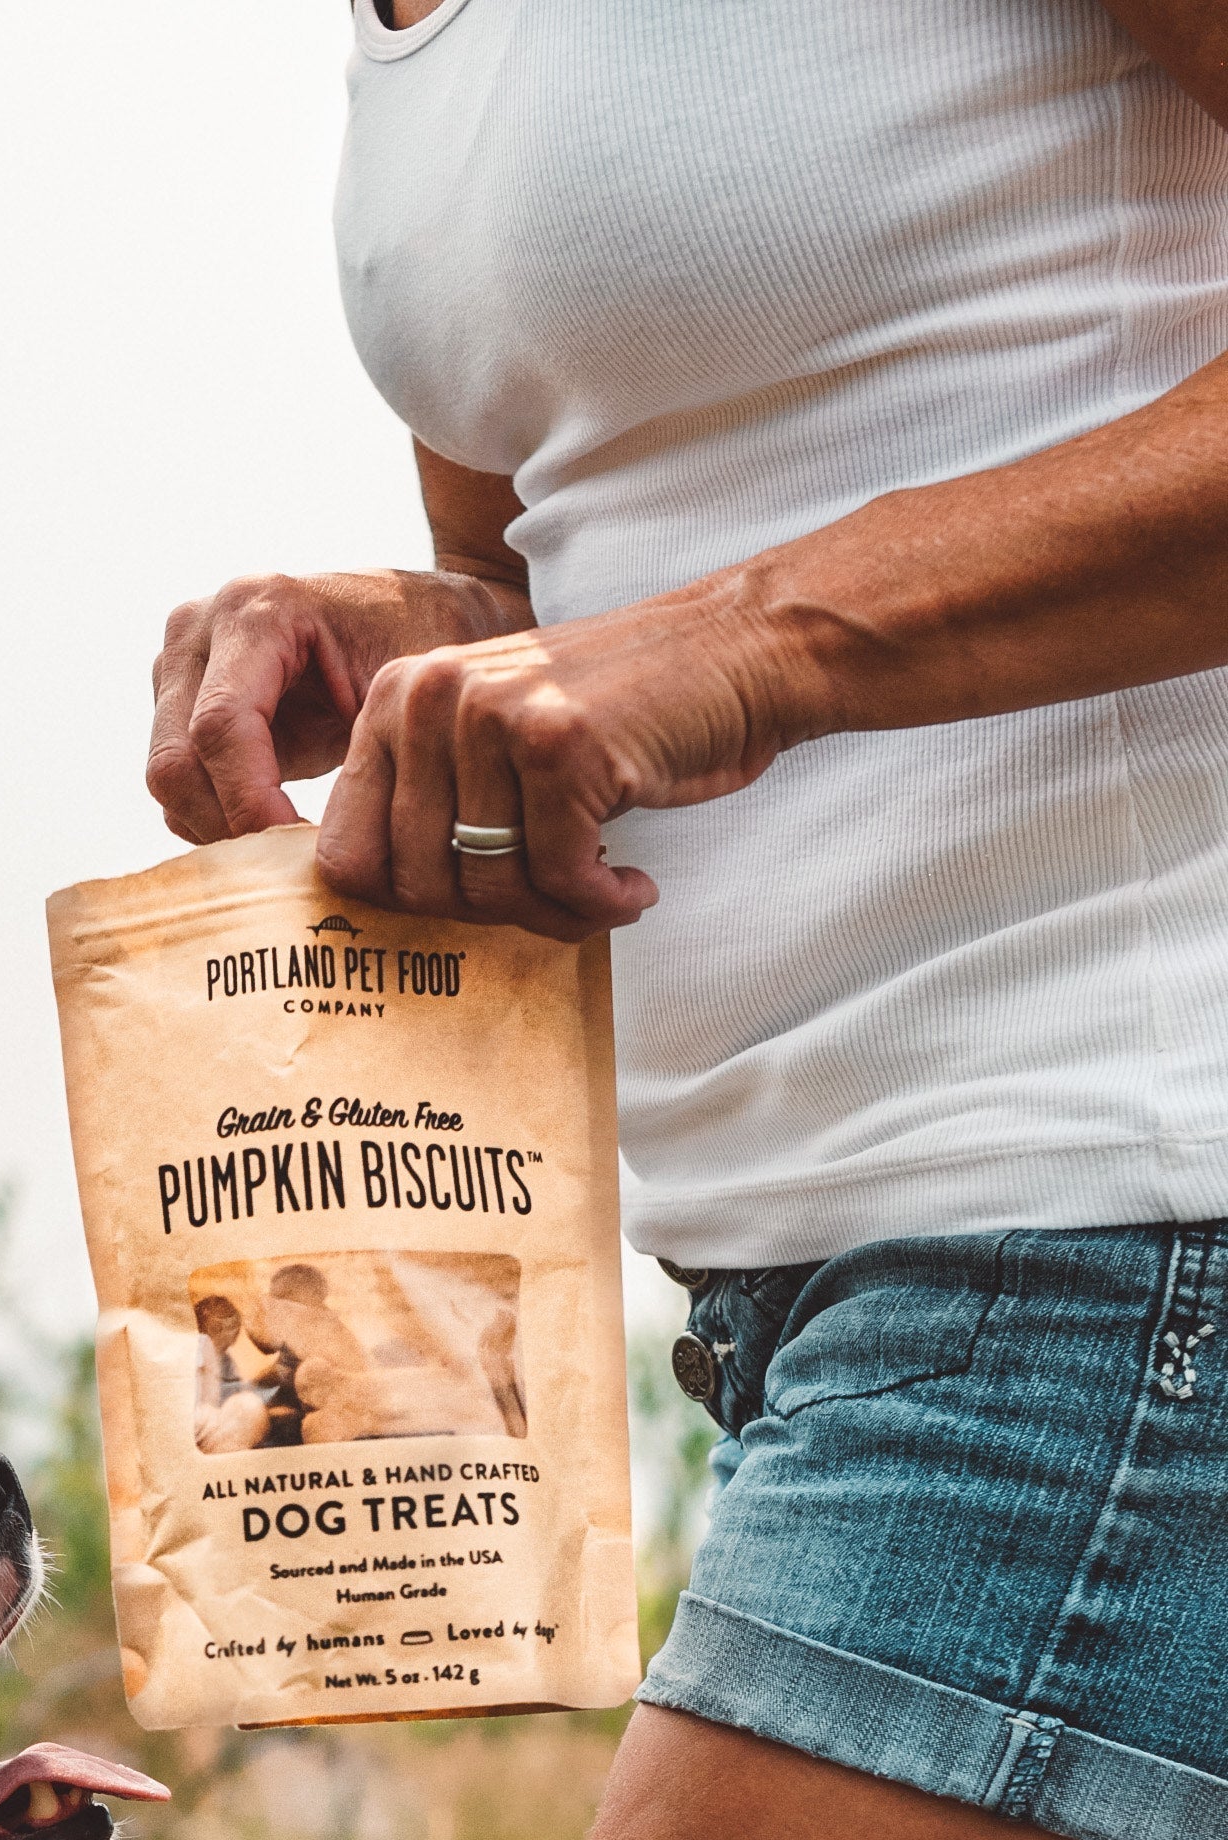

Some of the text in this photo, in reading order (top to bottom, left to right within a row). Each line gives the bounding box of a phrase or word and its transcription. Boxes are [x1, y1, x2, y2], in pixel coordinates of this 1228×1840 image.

[207, 945, 336, 1001] PORTLAND
[344, 946, 386, 994] PET
[283, 999, 385, 1018] COMPANY
[217, 1097, 464, 1138] Grain & Gluten Free
[158, 1140, 347, 1235] PUMPKIN
[202, 1463, 540, 1500] ALL NATURAL & HAND CRAFTED
[242, 1492, 520, 1543] DOG TREATS
[270, 1550, 503, 1580] Sourced and Made in the USA
[336, 1583, 447, 1604] Human Grade
[276, 1636, 297, 1657] by
[307, 1634, 385, 1651] humans
[447, 1620, 504, 1641] Loved
[513, 1622, 528, 1640] by
[325, 1675, 352, 1688] Net
[385, 1669, 397, 1685] 5
[432, 1664, 464, 1682] 142
[469, 1669, 480, 1685] g
